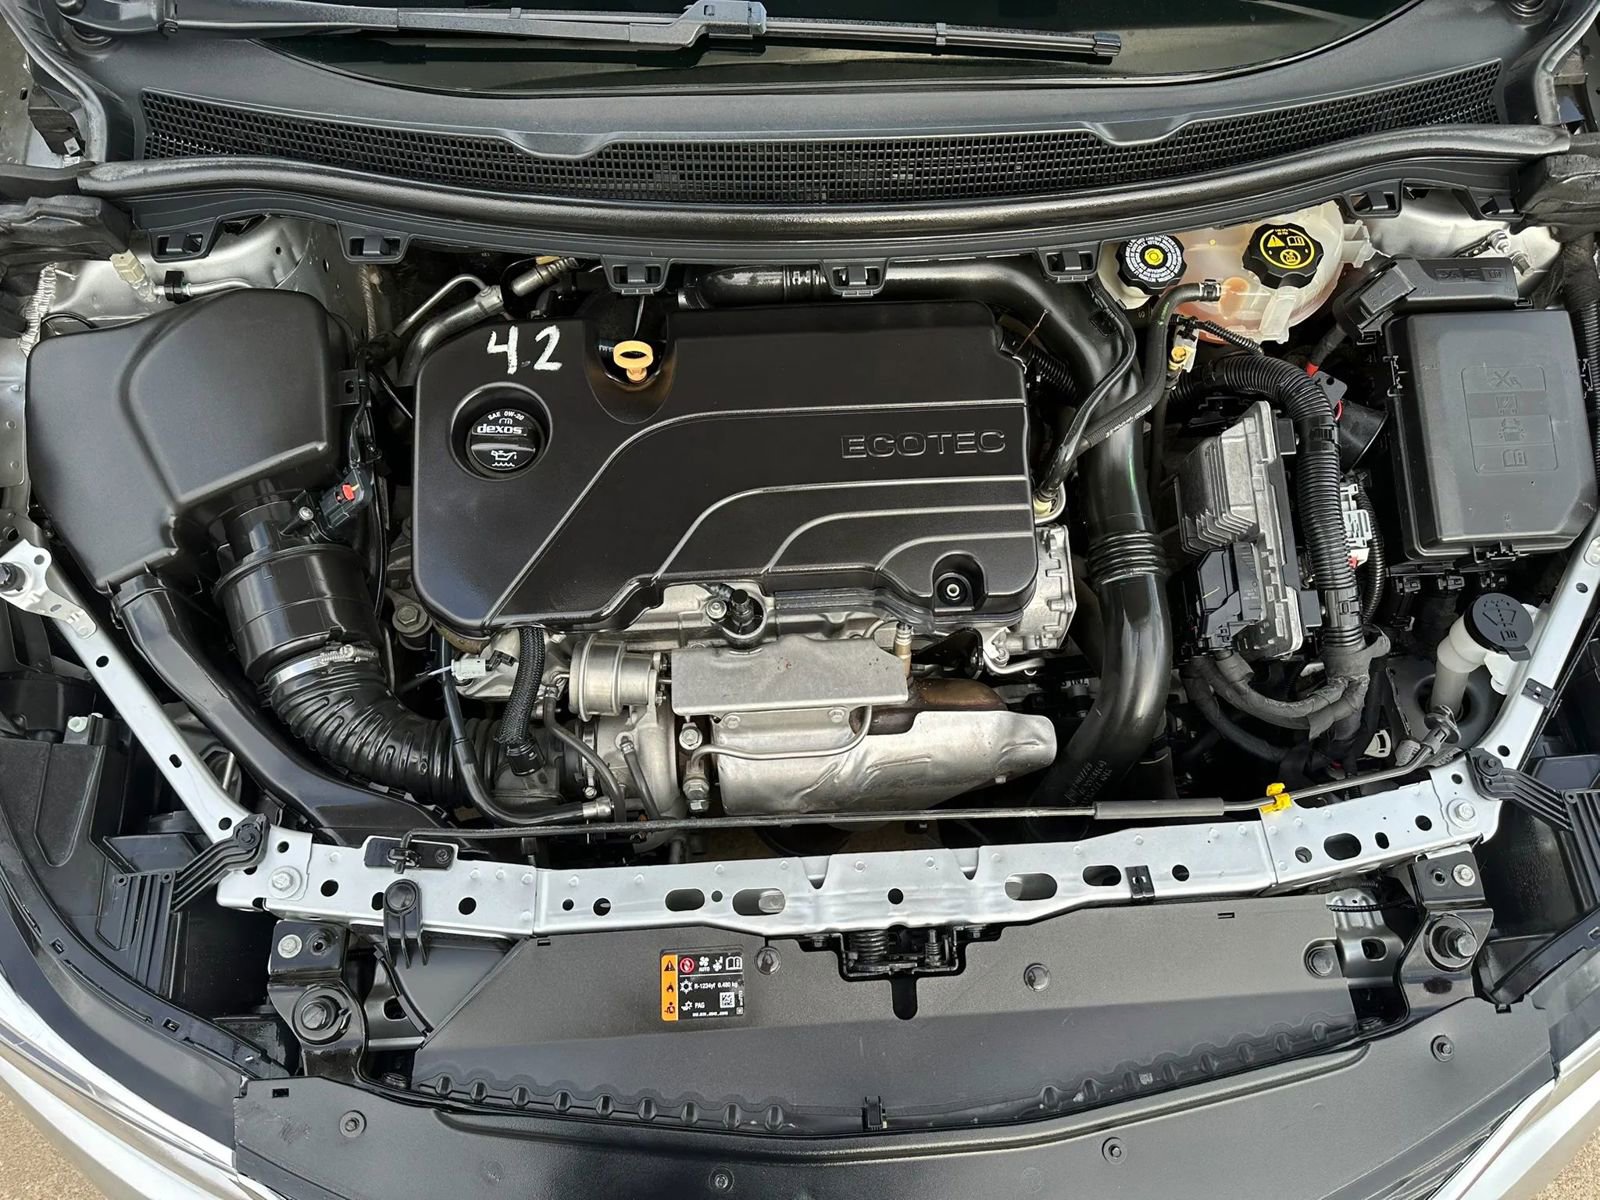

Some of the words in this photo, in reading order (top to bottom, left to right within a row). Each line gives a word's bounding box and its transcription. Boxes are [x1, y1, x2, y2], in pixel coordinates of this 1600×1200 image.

[487, 411, 501, 421] SAE
[503, 410, 525, 421] 0W-20
[477, 423, 523, 434] dexos
[840, 429, 1006, 459] ECOTEC
